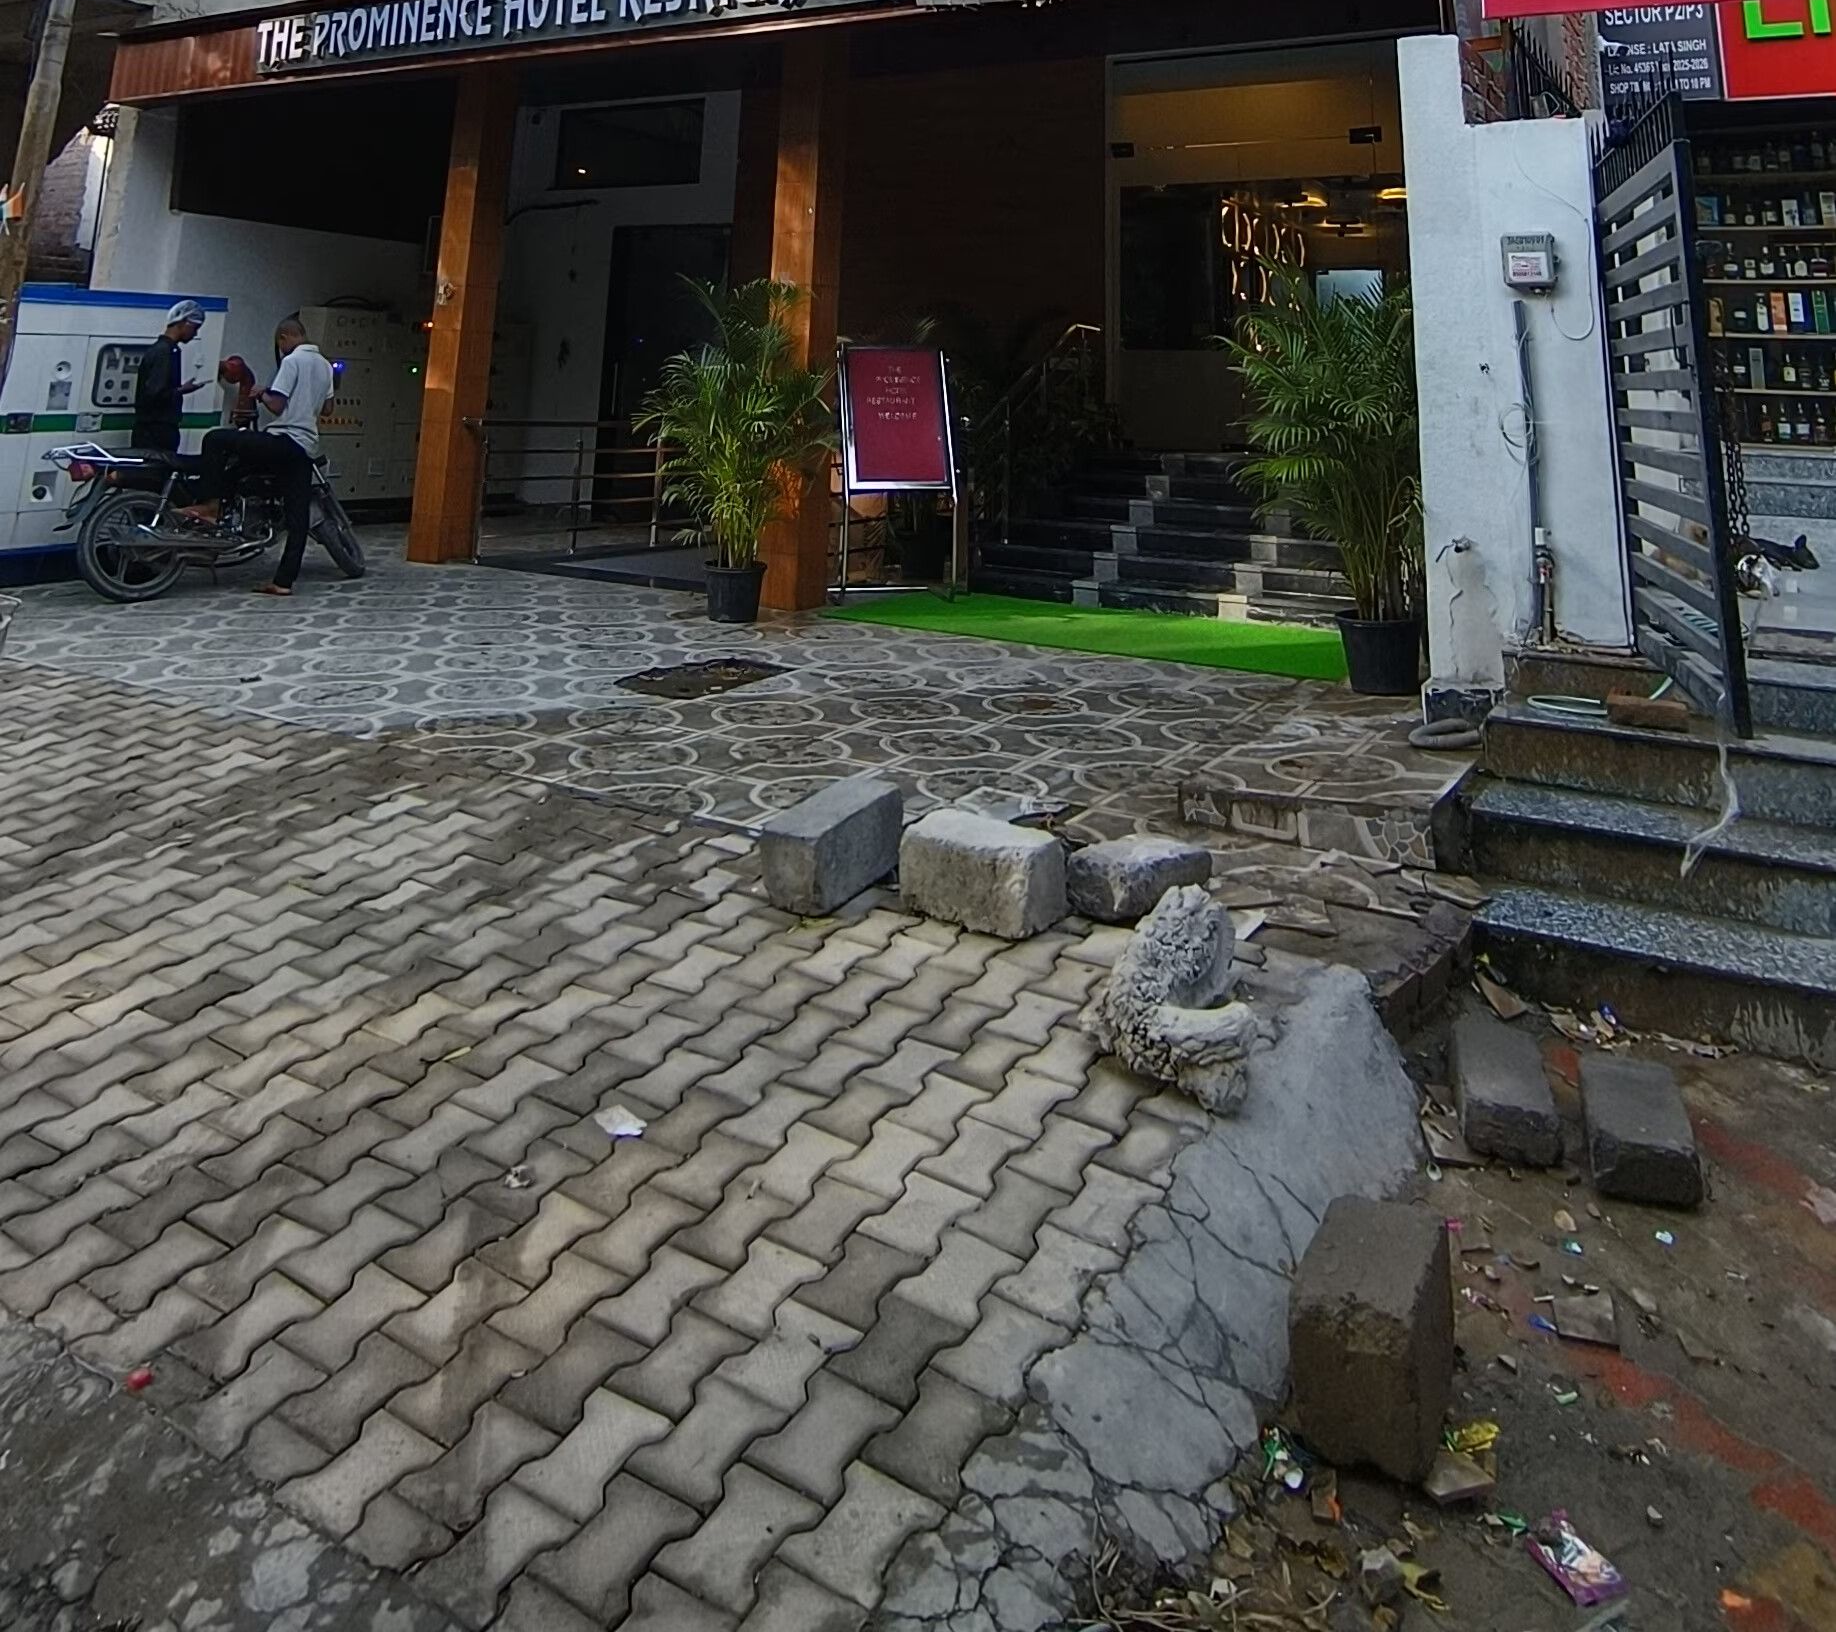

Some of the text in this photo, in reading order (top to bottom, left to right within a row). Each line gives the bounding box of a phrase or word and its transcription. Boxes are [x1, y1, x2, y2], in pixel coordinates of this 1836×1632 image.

[256, 18, 304, 65] THE
[1677, 38, 1707, 52] SINGH
[1610, 81, 1629, 95] SHOP
